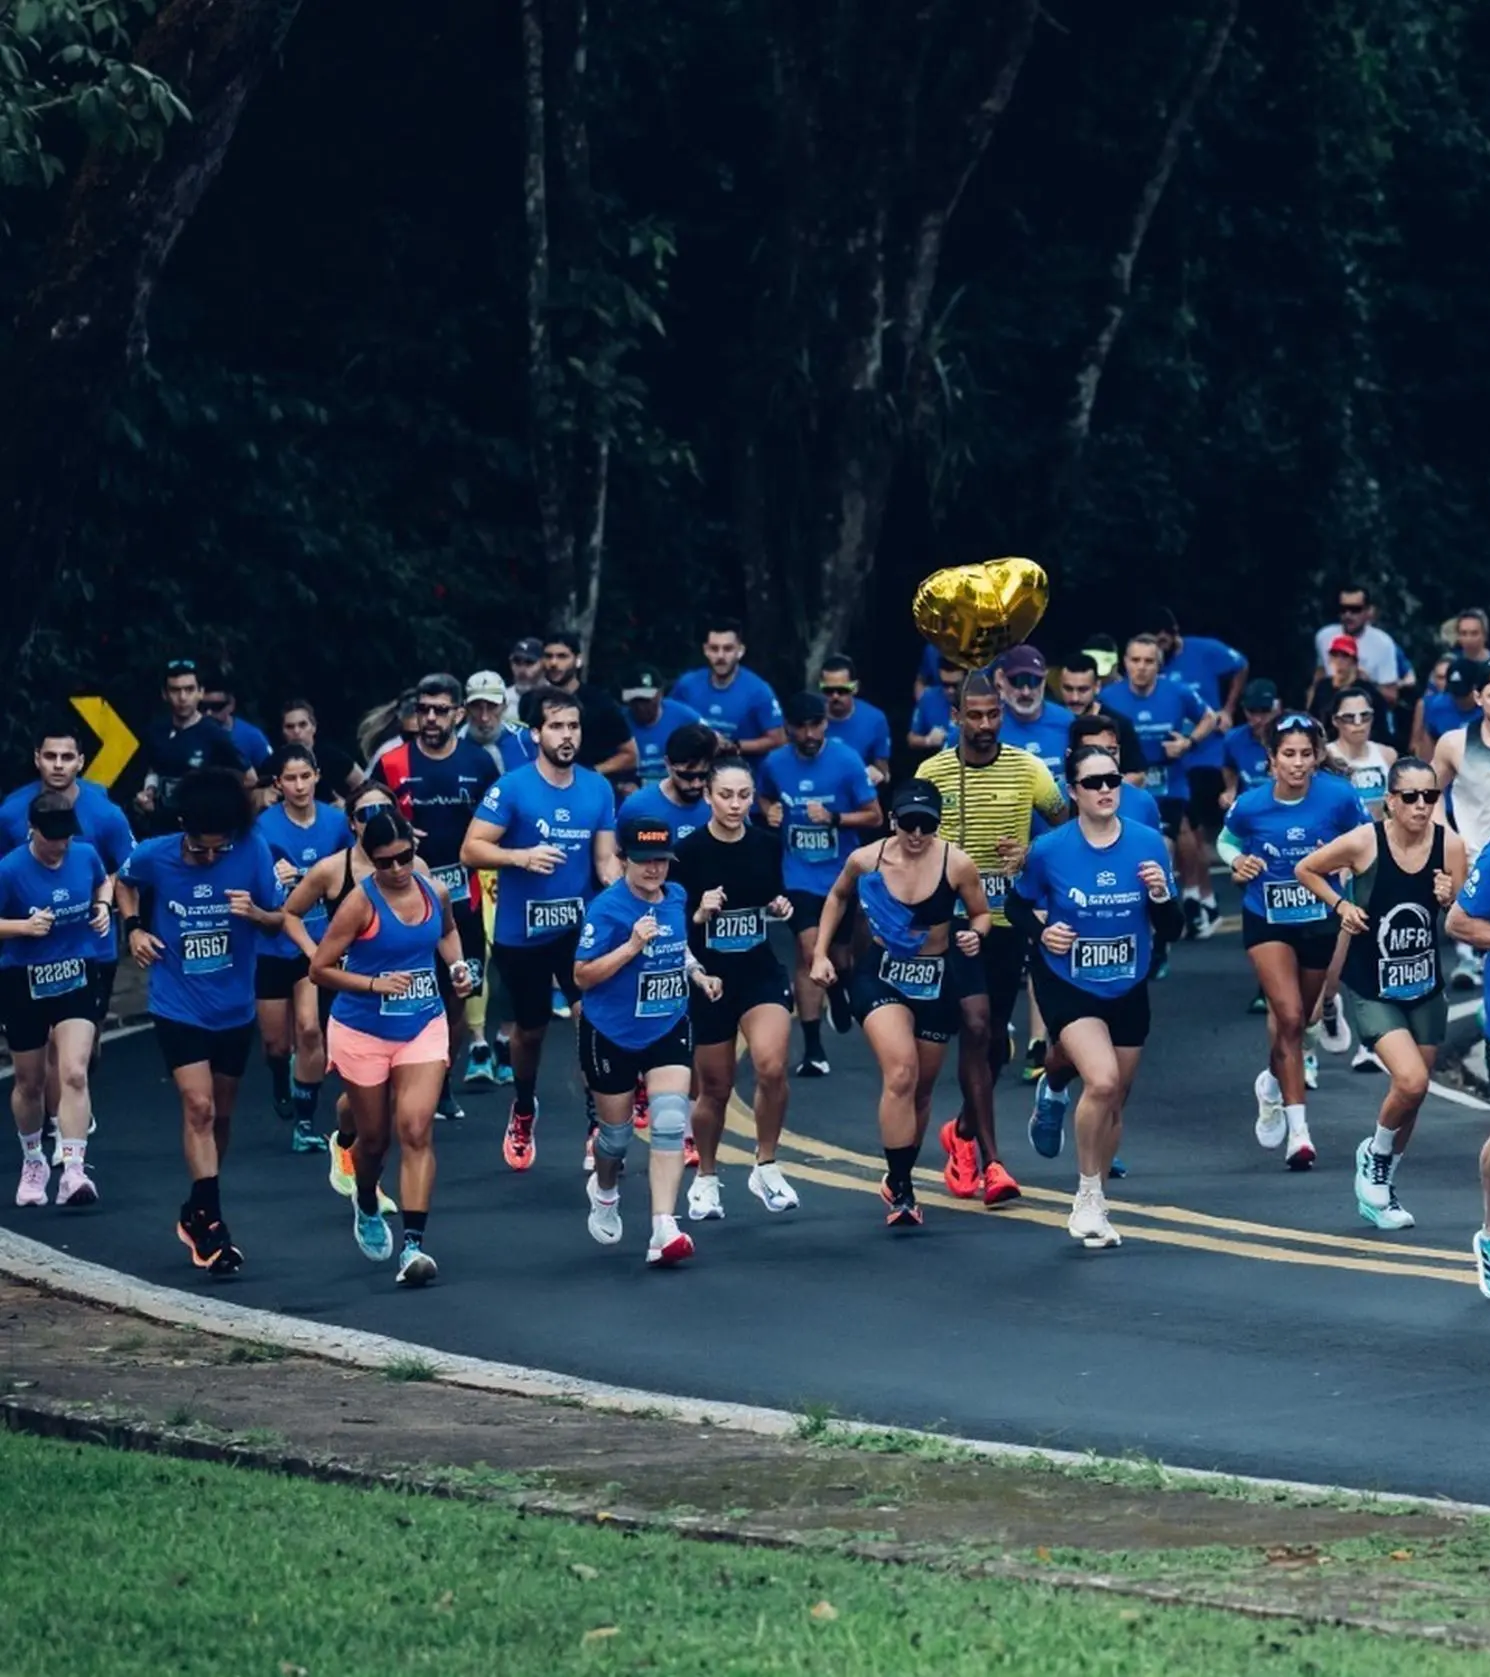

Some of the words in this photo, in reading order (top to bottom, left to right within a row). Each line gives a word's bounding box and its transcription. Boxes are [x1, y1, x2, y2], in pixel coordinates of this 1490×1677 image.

[796, 831, 829, 849] 21316
[1272, 886, 1316, 908] 21494
[535, 903, 578, 926] 21554
[716, 915, 757, 937] 21769
[185, 935, 228, 960] 21567
[1082, 943, 1128, 967] 21048
[34, 959, 81, 985] 22283
[889, 962, 935, 984] 21239
[389, 977, 433, 1000] 092
[647, 975, 683, 1001] 21272
